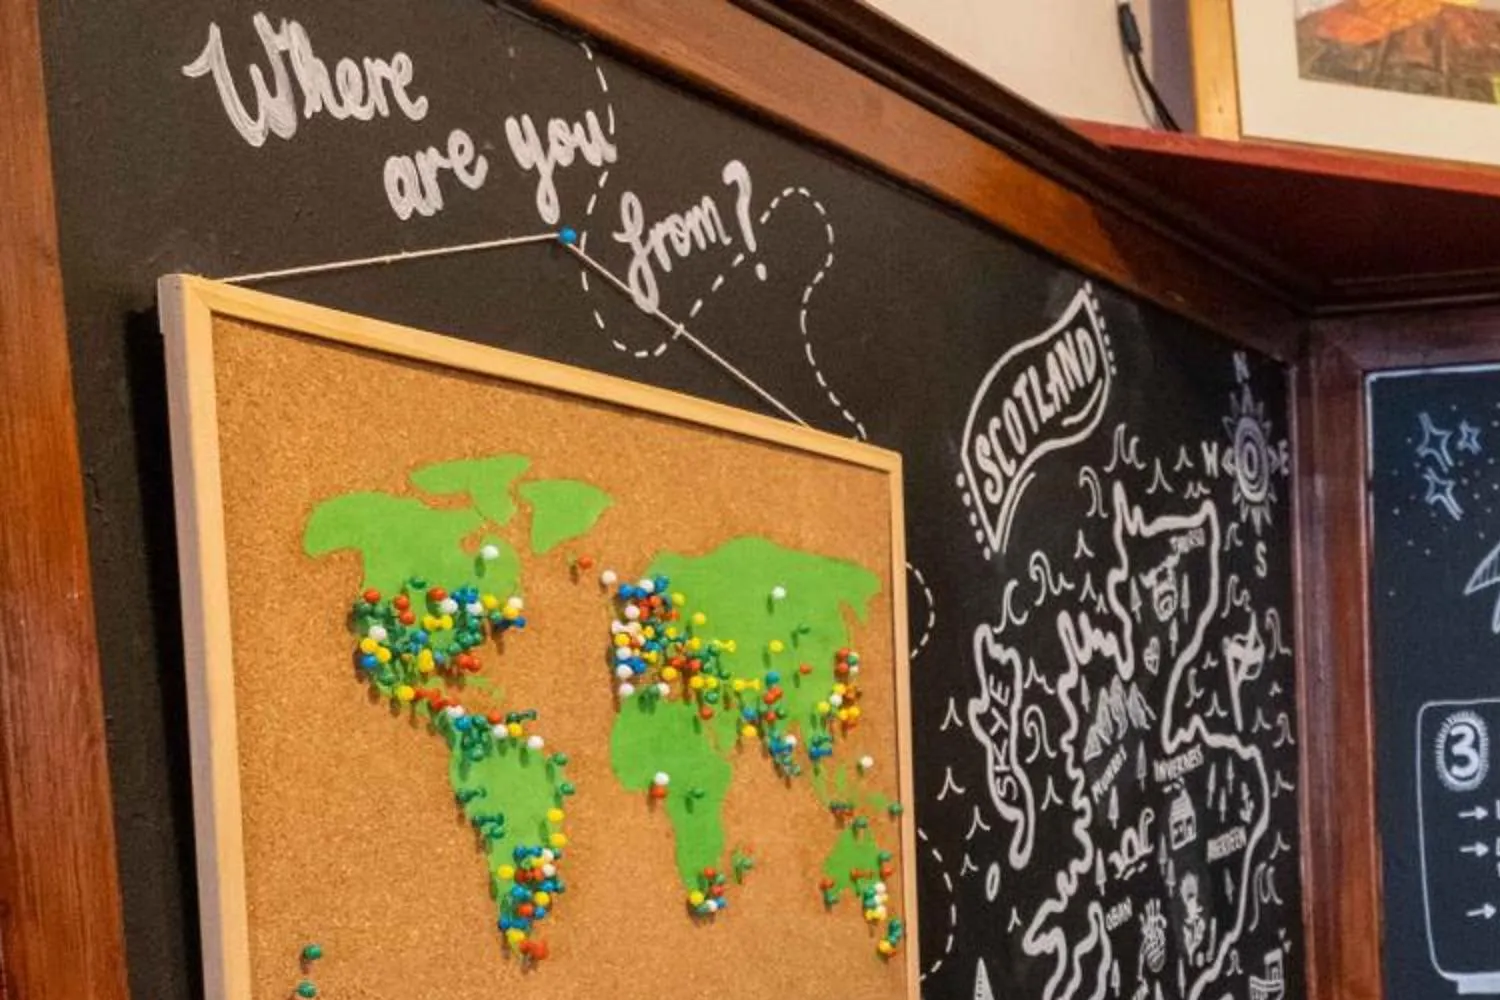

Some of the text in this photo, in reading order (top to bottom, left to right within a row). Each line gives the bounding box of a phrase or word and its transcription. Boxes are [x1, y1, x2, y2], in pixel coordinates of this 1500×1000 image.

[182, 11, 428, 146] Where
[383, 110, 618, 224] are you
[613, 160, 768, 311] from?
[975, 325, 1097, 504] SCOTLAND
[1255, 541, 1267, 578] S
[990, 673, 1018, 801] SKYE
[1450, 723, 1479, 778] 3
